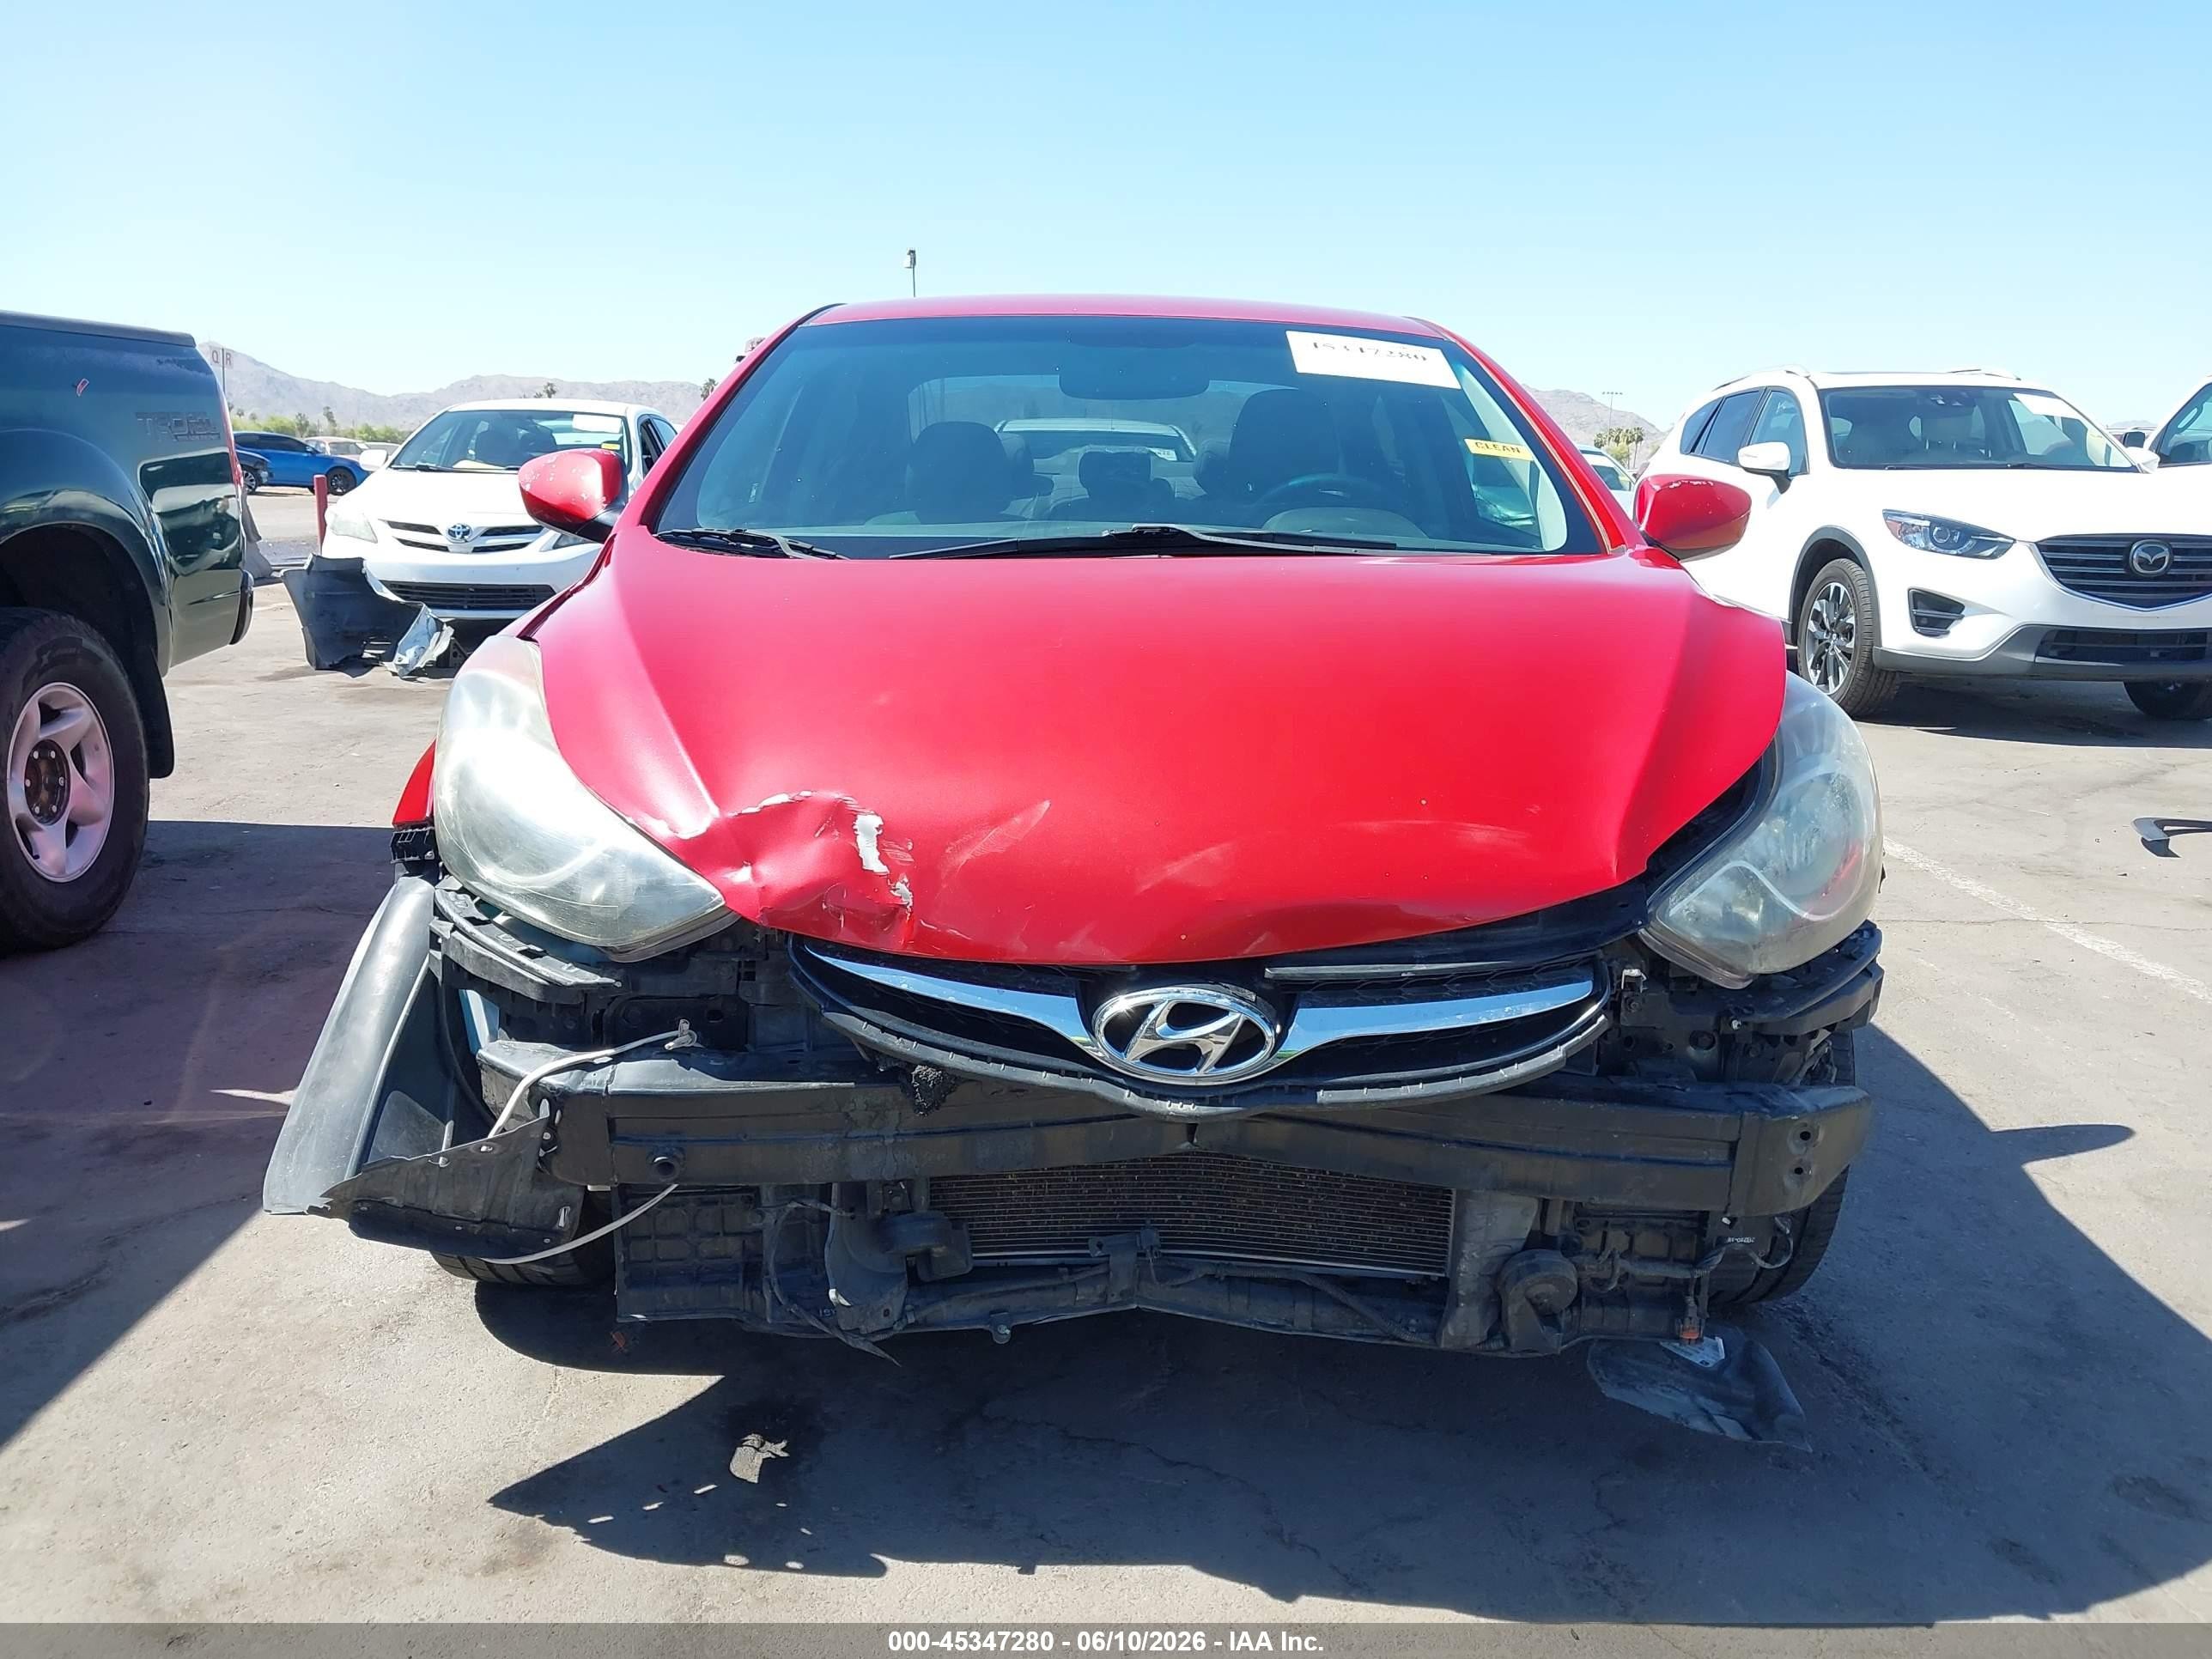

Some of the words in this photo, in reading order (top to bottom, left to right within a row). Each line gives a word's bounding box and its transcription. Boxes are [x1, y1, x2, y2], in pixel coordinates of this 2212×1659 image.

[211, 349, 220, 364] Q
[225, 352, 232, 366] R
[1474, 441, 1521, 453] CLEAN
